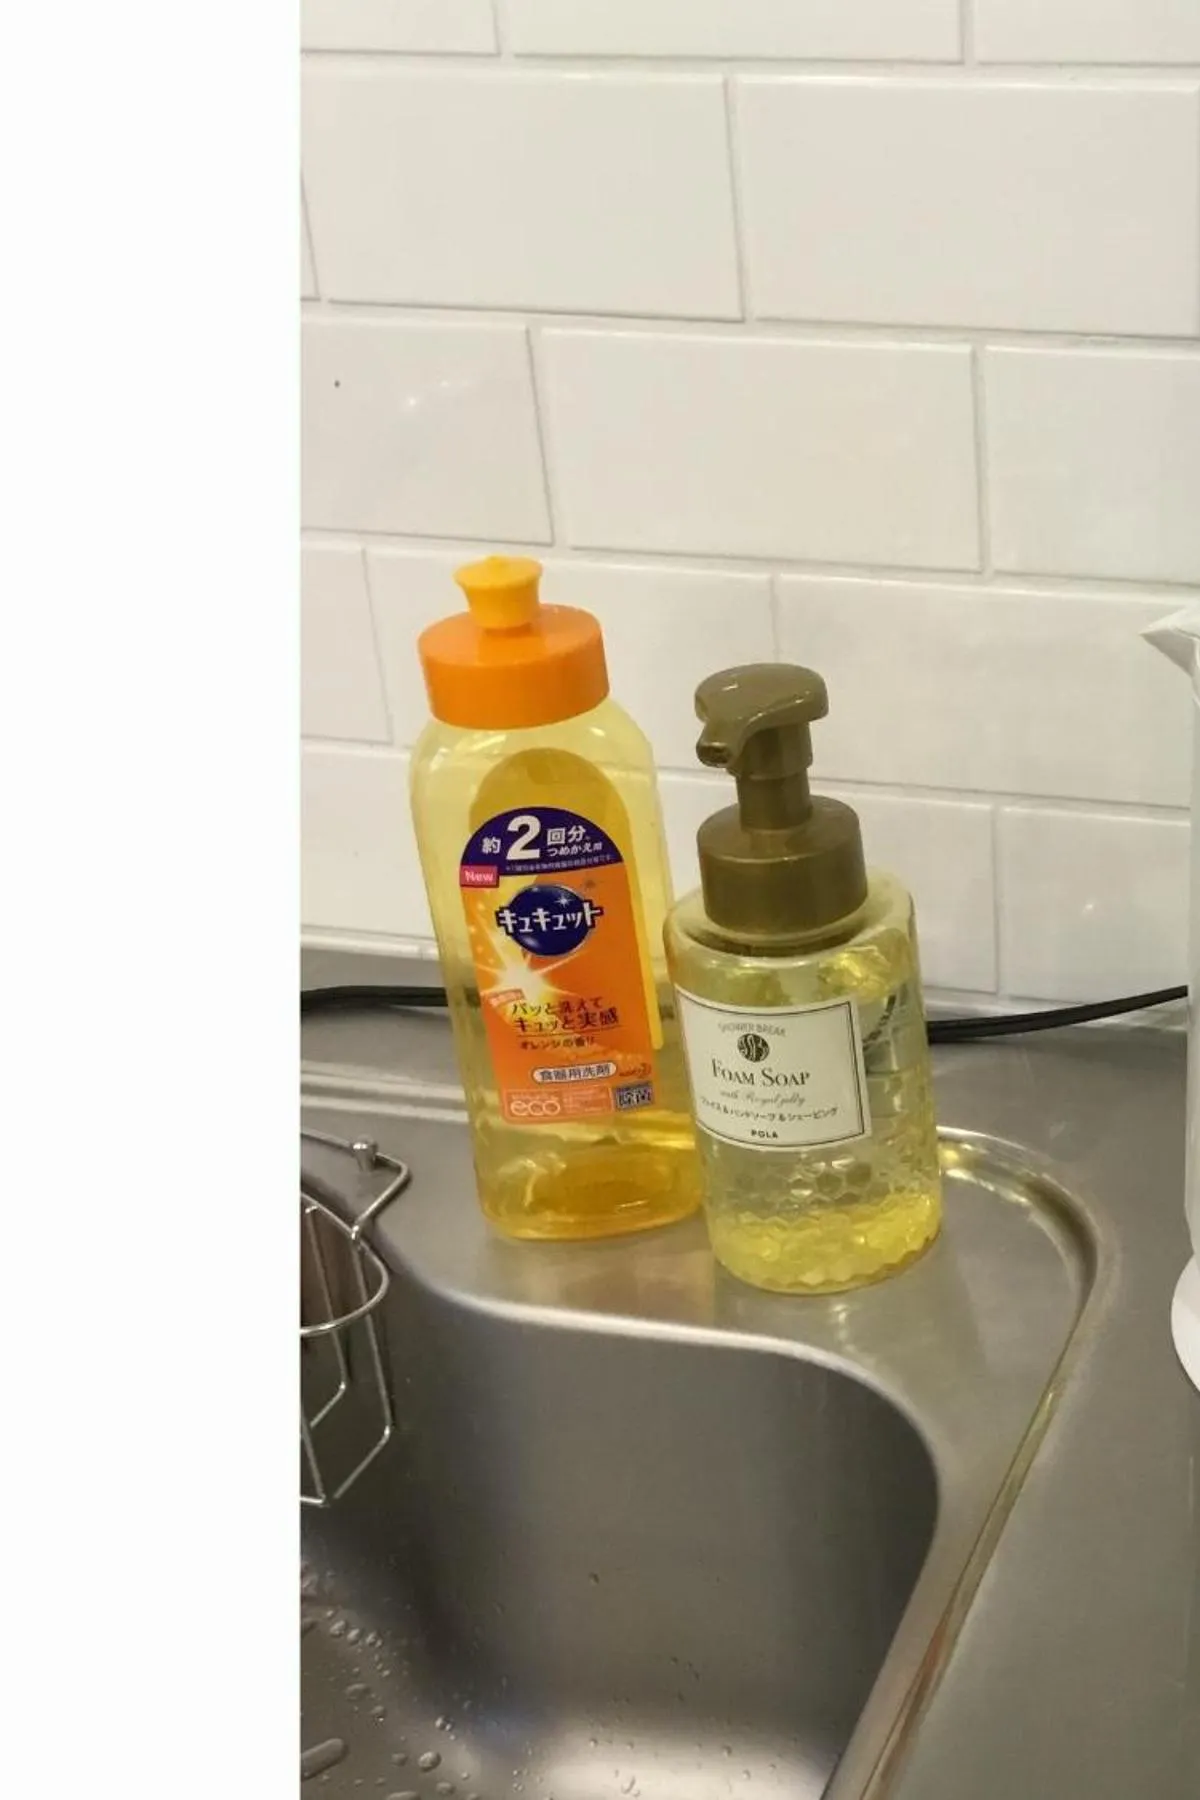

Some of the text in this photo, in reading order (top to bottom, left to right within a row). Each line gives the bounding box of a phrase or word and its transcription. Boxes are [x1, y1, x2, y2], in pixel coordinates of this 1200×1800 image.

[464, 870, 494, 883] New
[497, 901, 602, 934] キュキュット
[510, 1099, 561, 1117] eco
[751, 1129, 779, 1138] POLA
